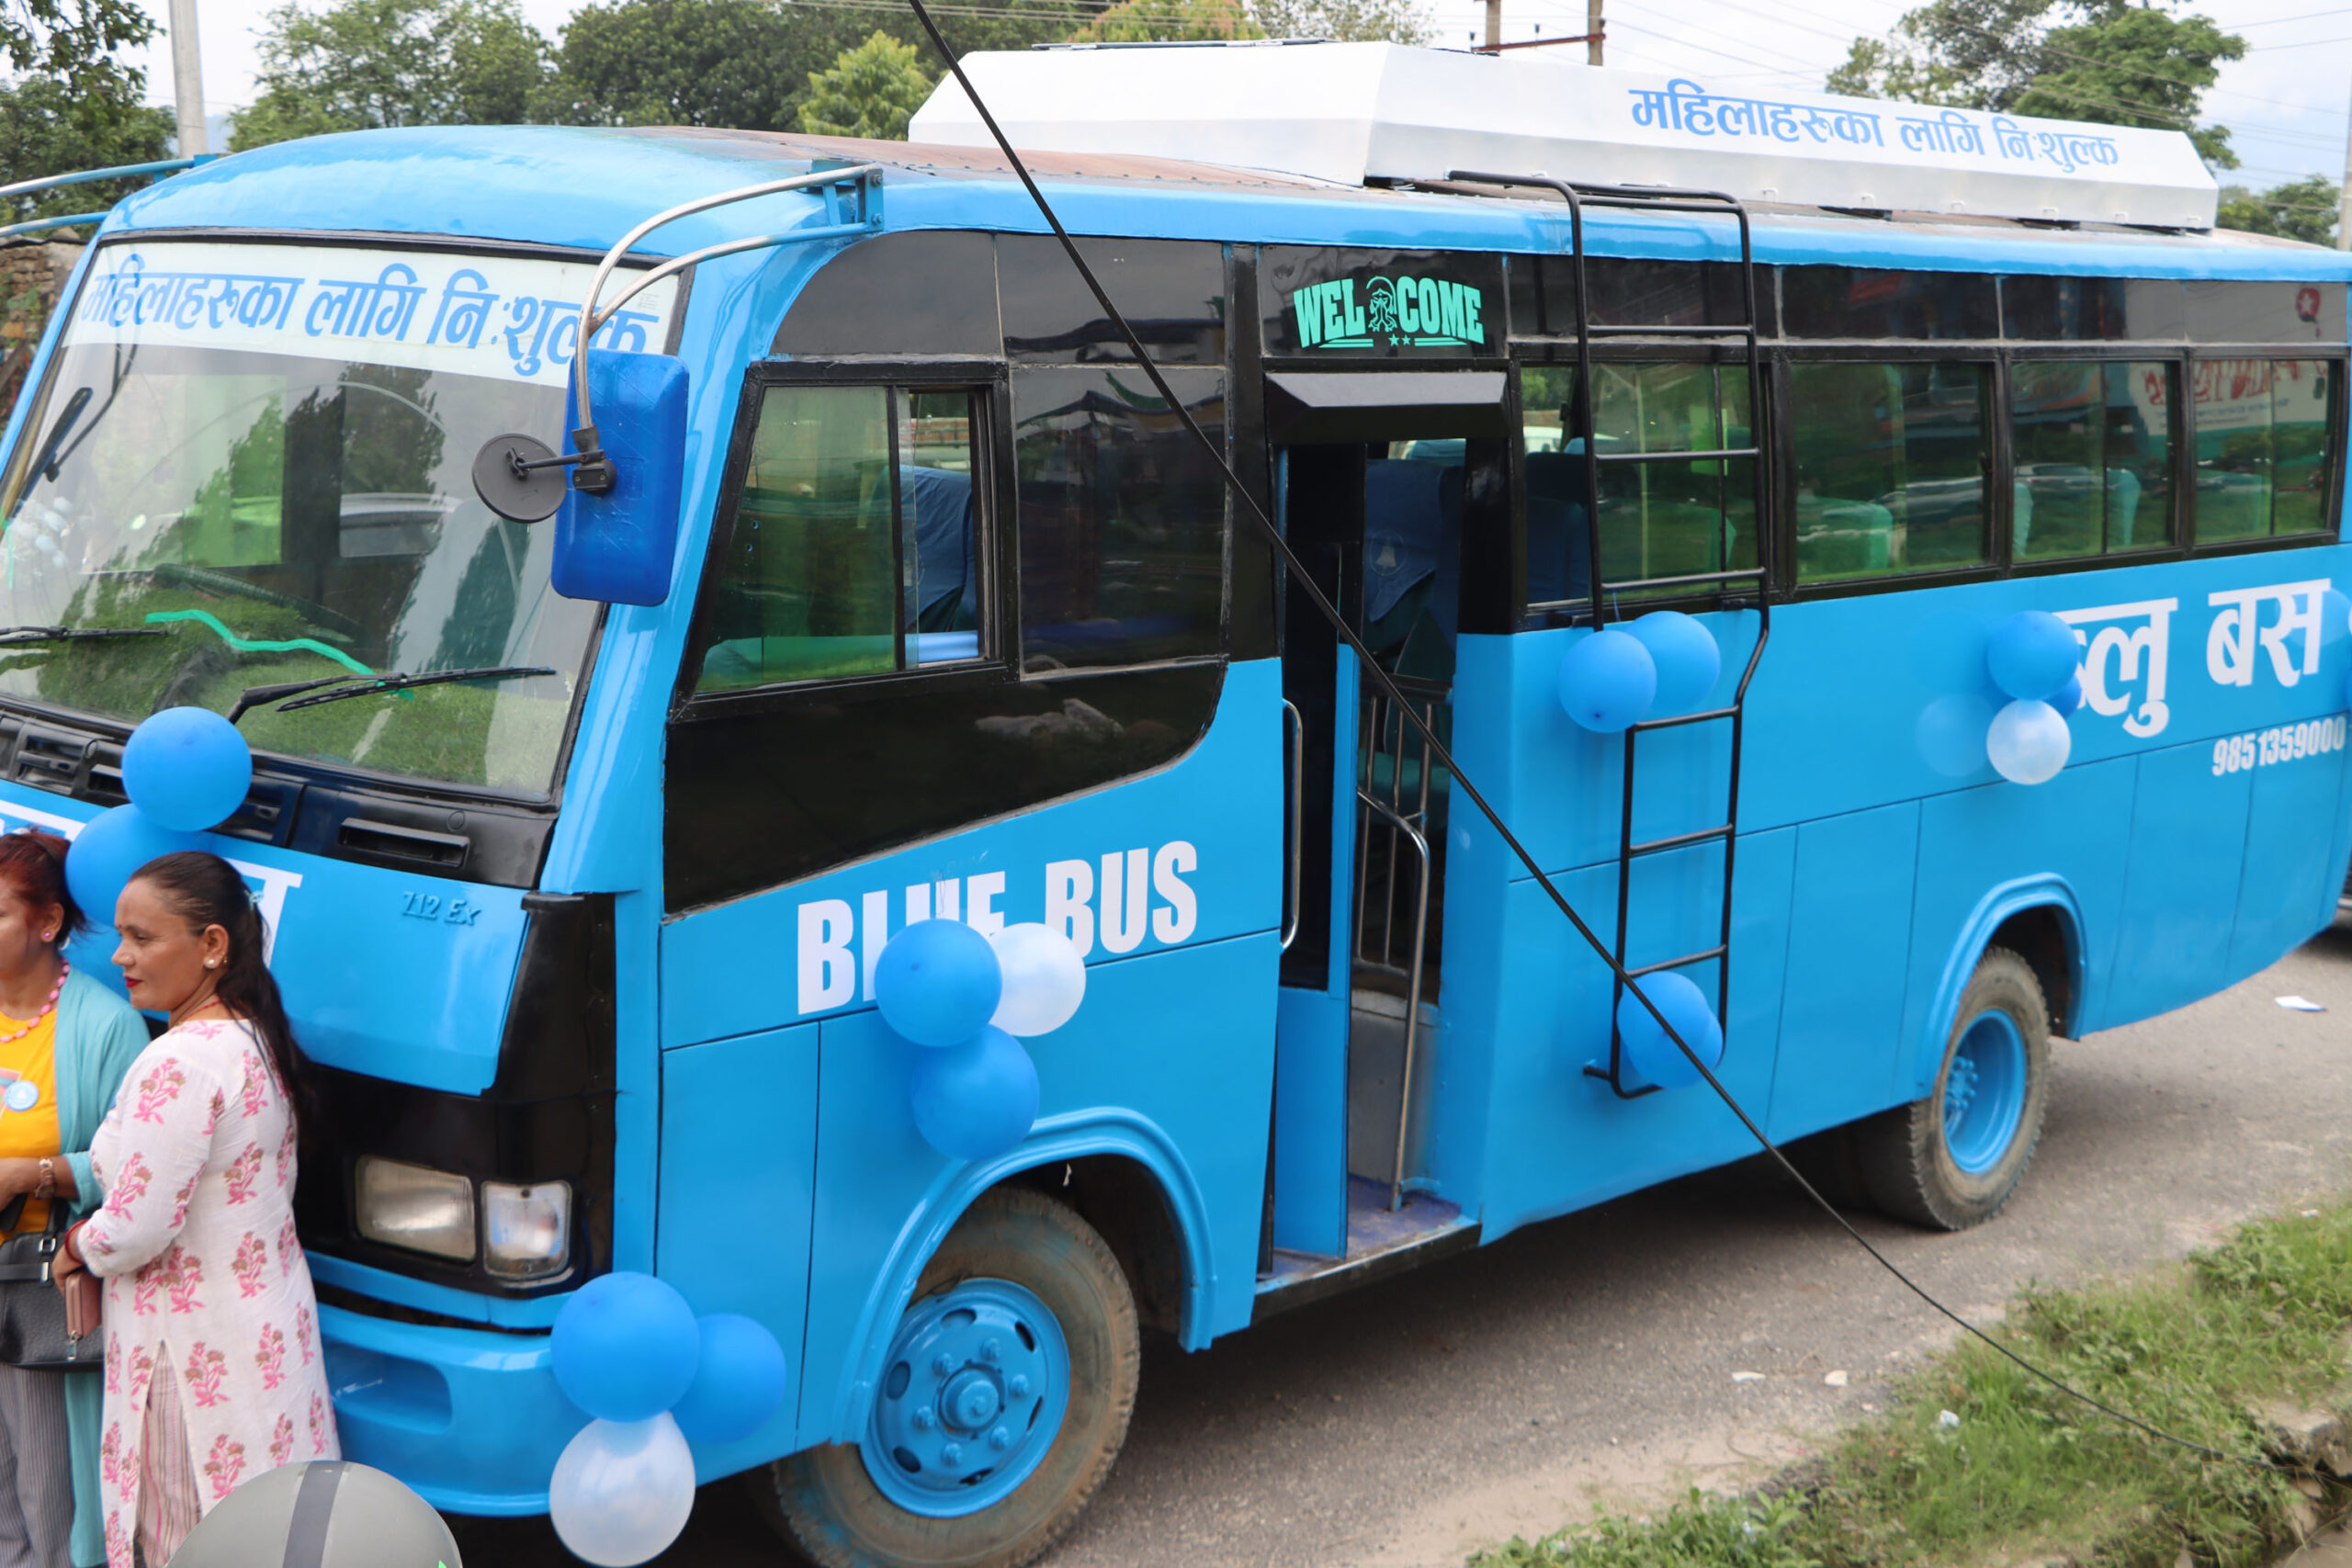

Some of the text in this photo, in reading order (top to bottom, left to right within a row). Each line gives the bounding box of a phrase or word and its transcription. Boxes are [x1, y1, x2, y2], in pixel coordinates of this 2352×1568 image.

[1895, 109, 1985, 155] लागि
[304, 263, 427, 342] लागि
[2207, 578, 2332, 688] बस
[2211, 716, 2346, 776] 9851359000
[401, 890, 441, 921] 712
[1045, 840, 1198, 958] BUS
